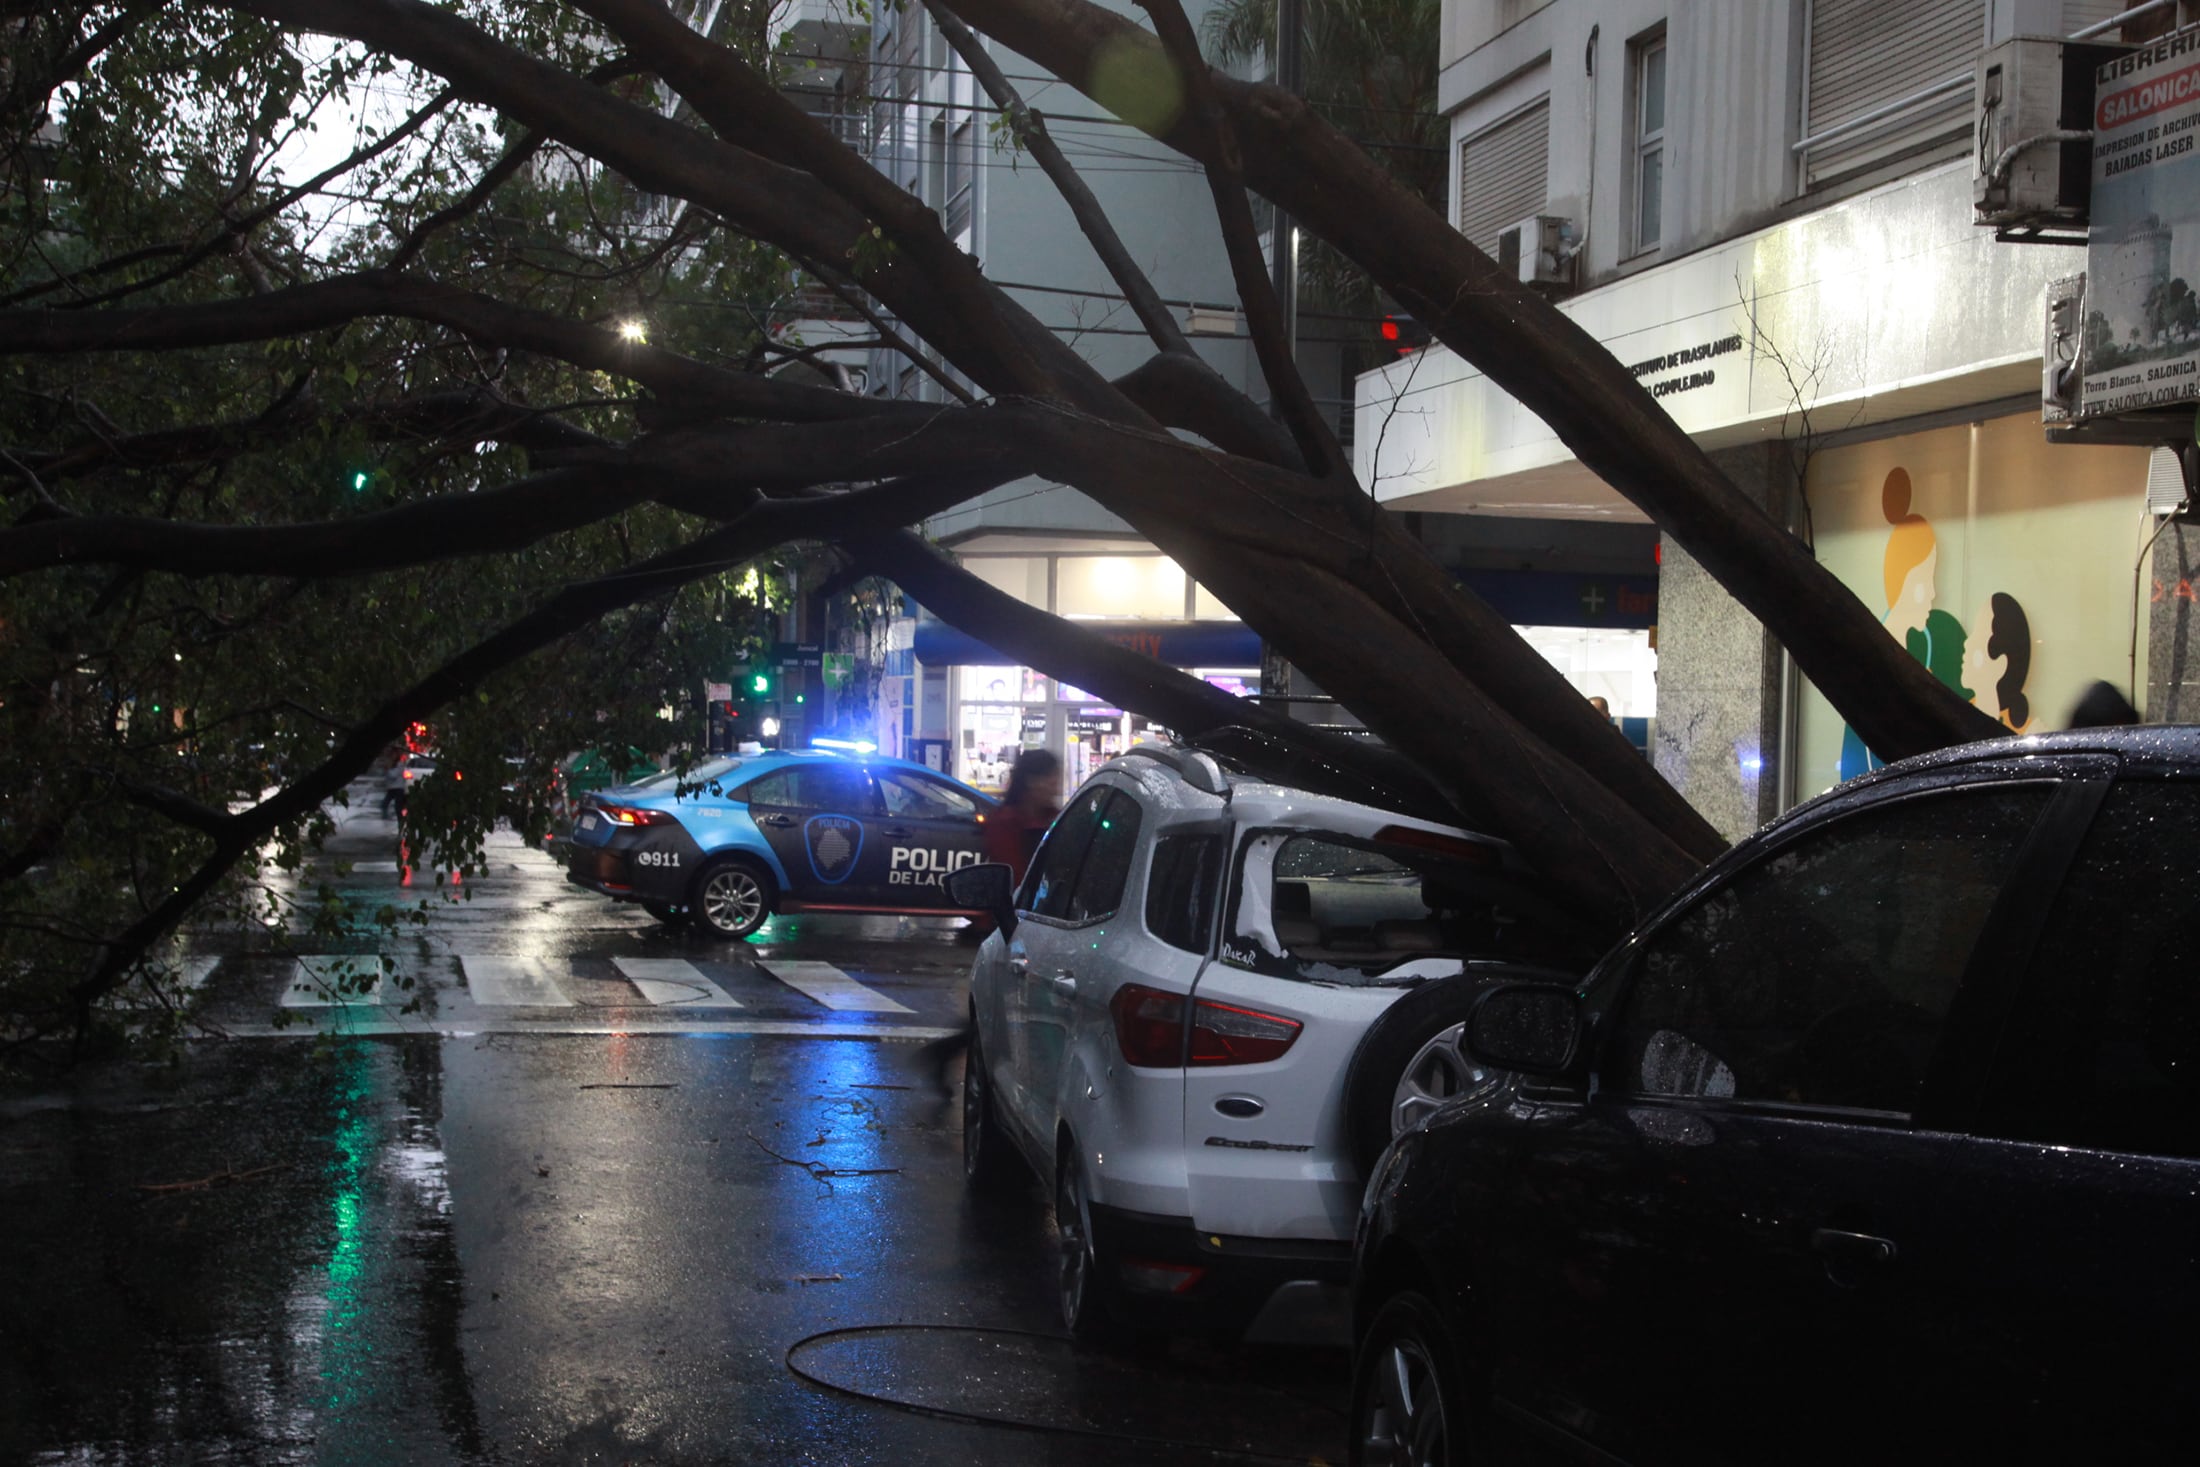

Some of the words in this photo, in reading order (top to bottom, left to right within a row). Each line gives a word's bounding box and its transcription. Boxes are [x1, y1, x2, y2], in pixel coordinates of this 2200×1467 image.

[2104, 69, 2200, 123] SALONICA
[2095, 131, 2145, 159] IMPRESION
[2148, 126, 2160, 142] DE
[2156, 135, 2193, 161] LASER
[1627, 356, 1666, 378] STITUTO
[1667, 352, 1679, 369] DE
[1680, 334, 1742, 366] TRASPLANTES
[1653, 370, 1715, 398] COMPLEJIDAD
[2085, 381, 2107, 394] Torre
[2147, 360, 2197, 381] SALONICA
[652, 851, 680, 867] 911
[891, 847, 986, 873] POLICI
[889, 870, 912, 885] DE
[915, 872, 936, 886] LA
